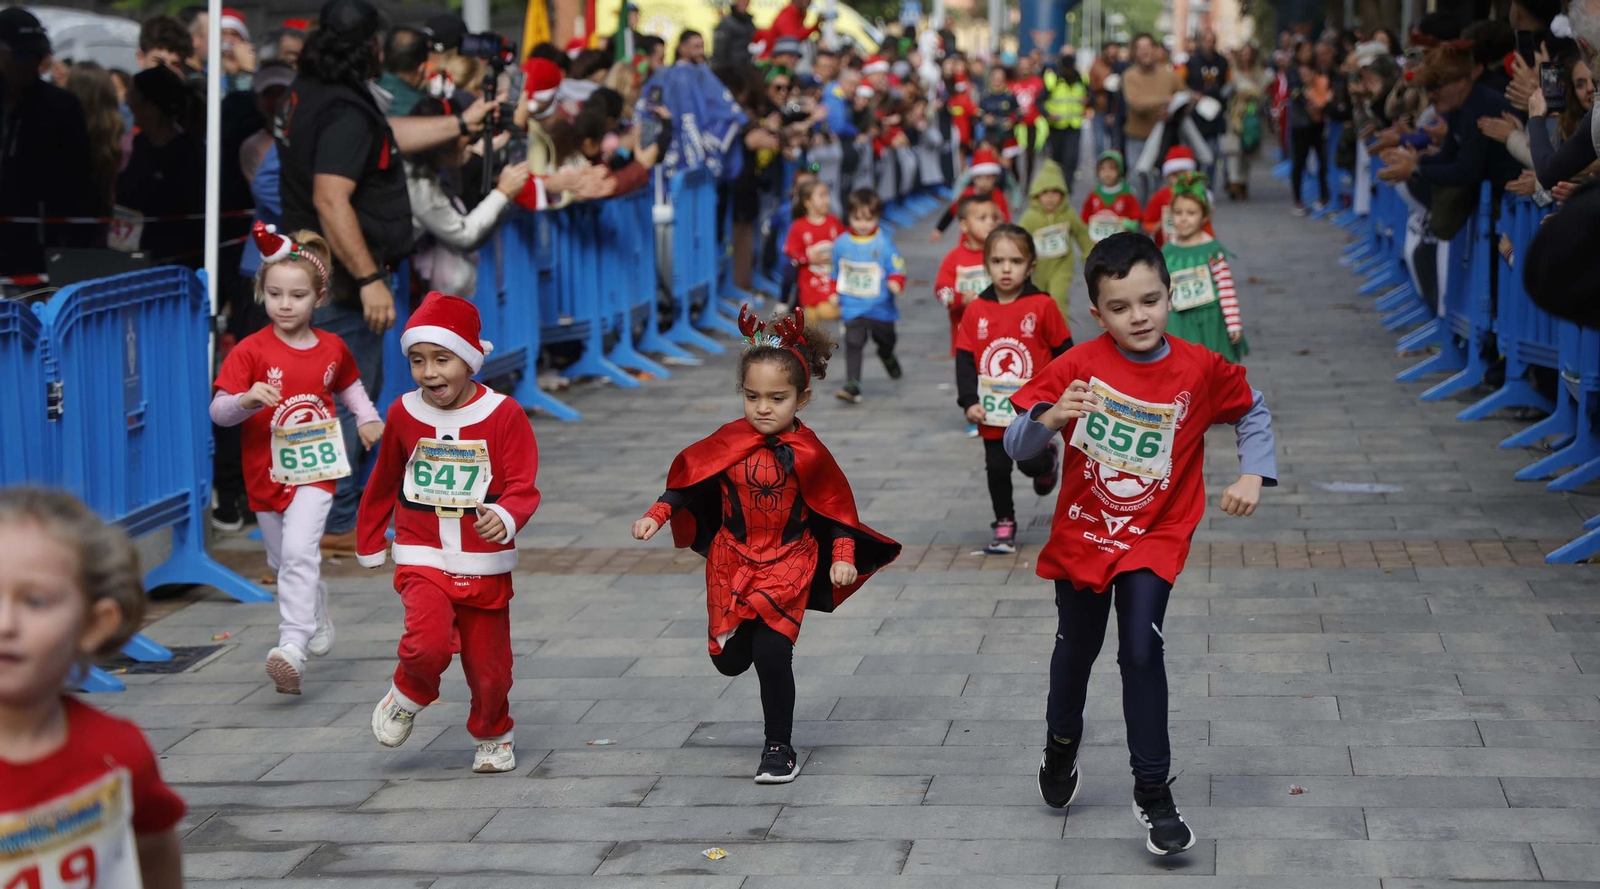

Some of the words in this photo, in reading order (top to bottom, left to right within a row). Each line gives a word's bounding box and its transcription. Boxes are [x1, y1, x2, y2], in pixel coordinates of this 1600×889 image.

[1086, 411, 1163, 459] 656
[279, 442, 337, 470] 658
[413, 460, 480, 491] 647
[1090, 485, 1110, 506] CIUDAD
[1109, 502, 1119, 511] DE
[1119, 495, 1155, 512] ALGECIRAS
